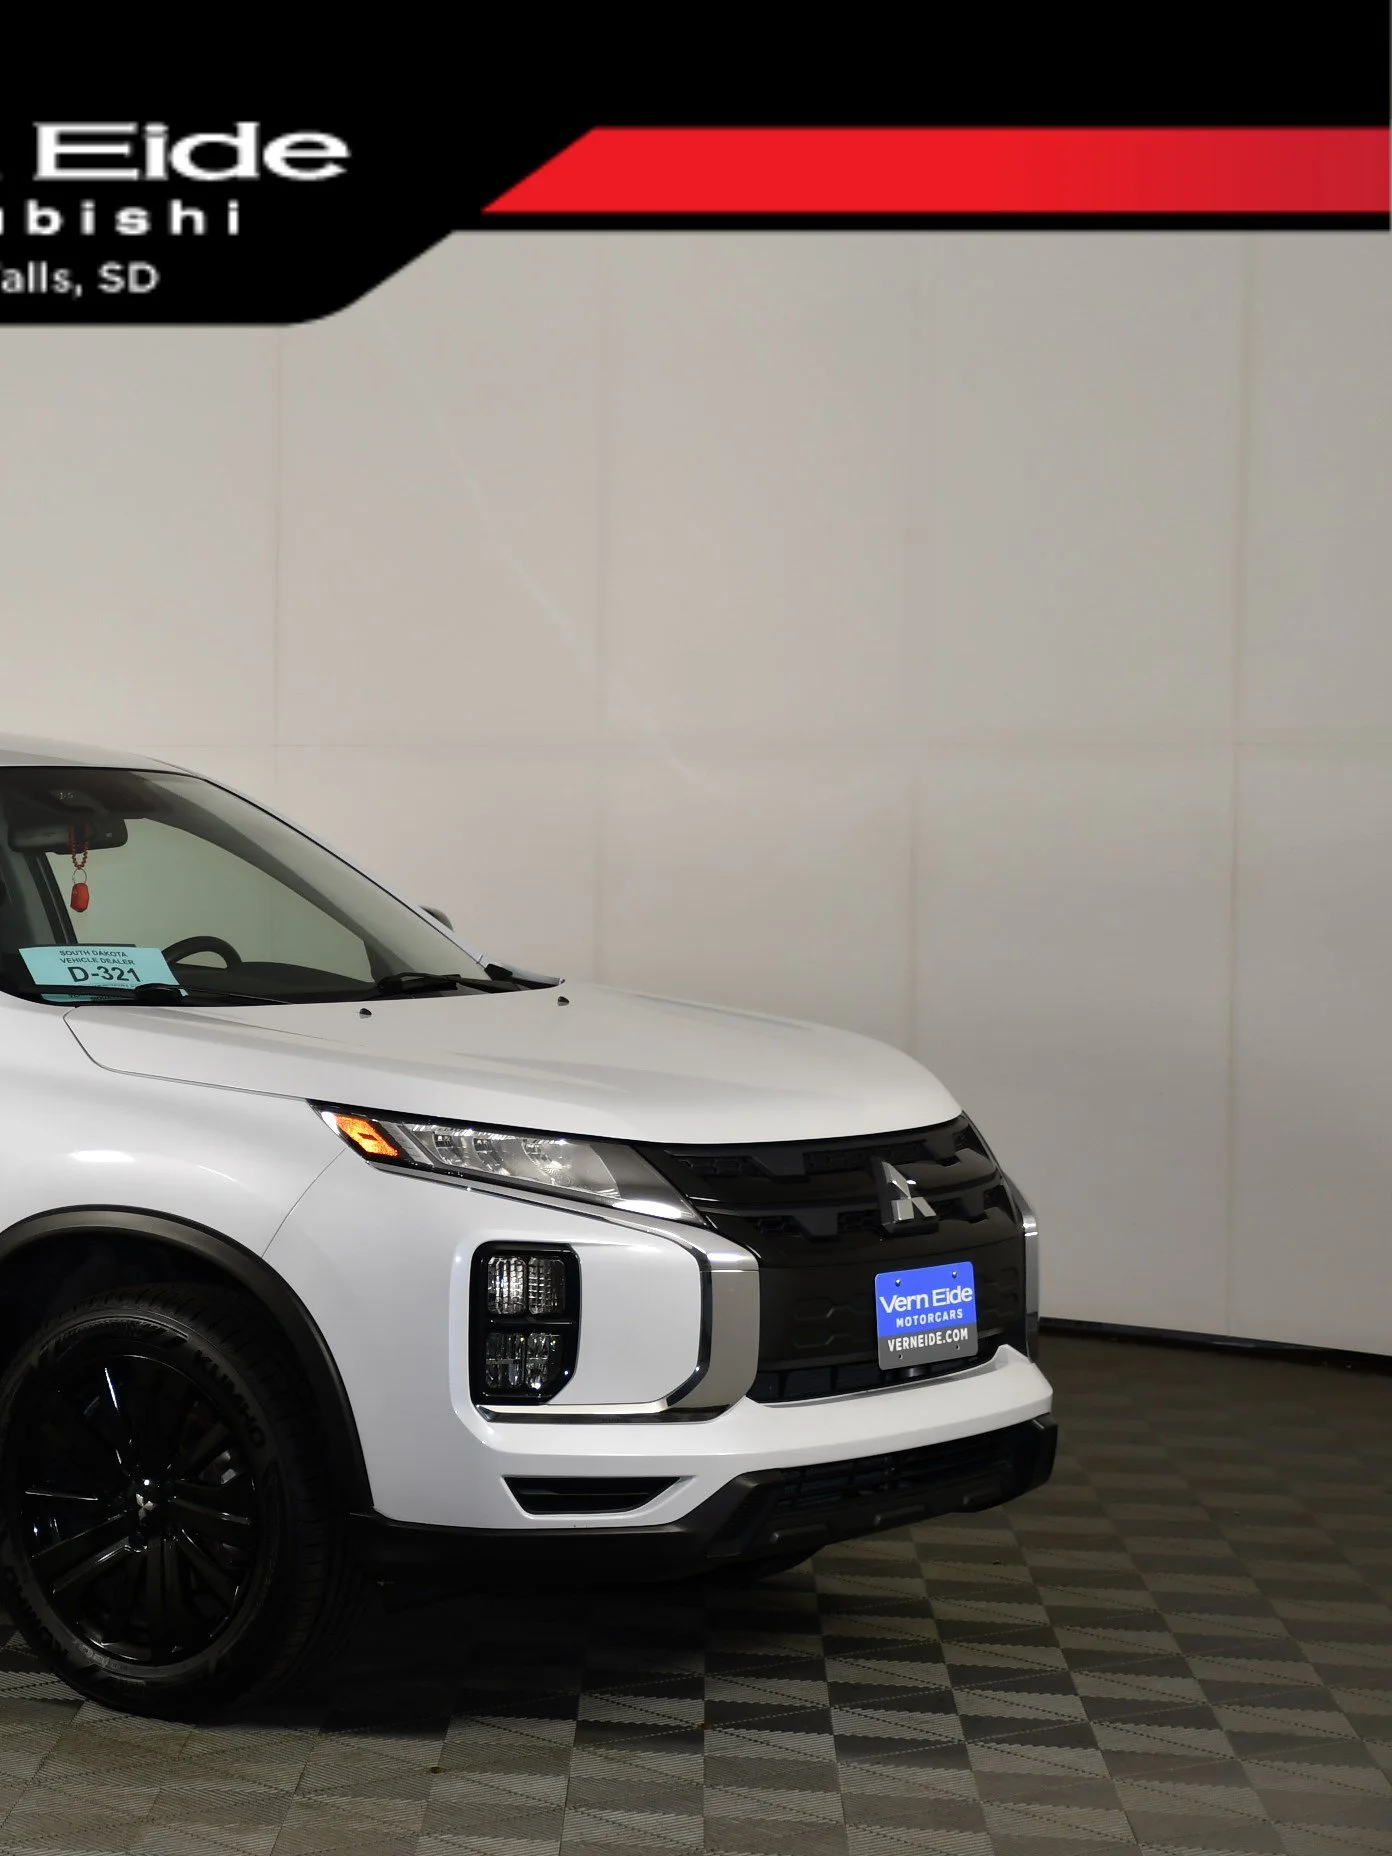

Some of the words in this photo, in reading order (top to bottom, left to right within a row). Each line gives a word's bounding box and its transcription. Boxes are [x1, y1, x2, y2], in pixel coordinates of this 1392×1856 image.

[92, 950, 128, 958] DAKOTA
[100, 958, 135, 966] DEALER
[68, 966, 141, 983] D-321
[879, 1294, 929, 1314] Vern
[931, 1285, 973, 1307] Eide
[896, 1308, 963, 1328] MOTORCARS
[888, 1327, 969, 1352] VERNEIDE.COM
